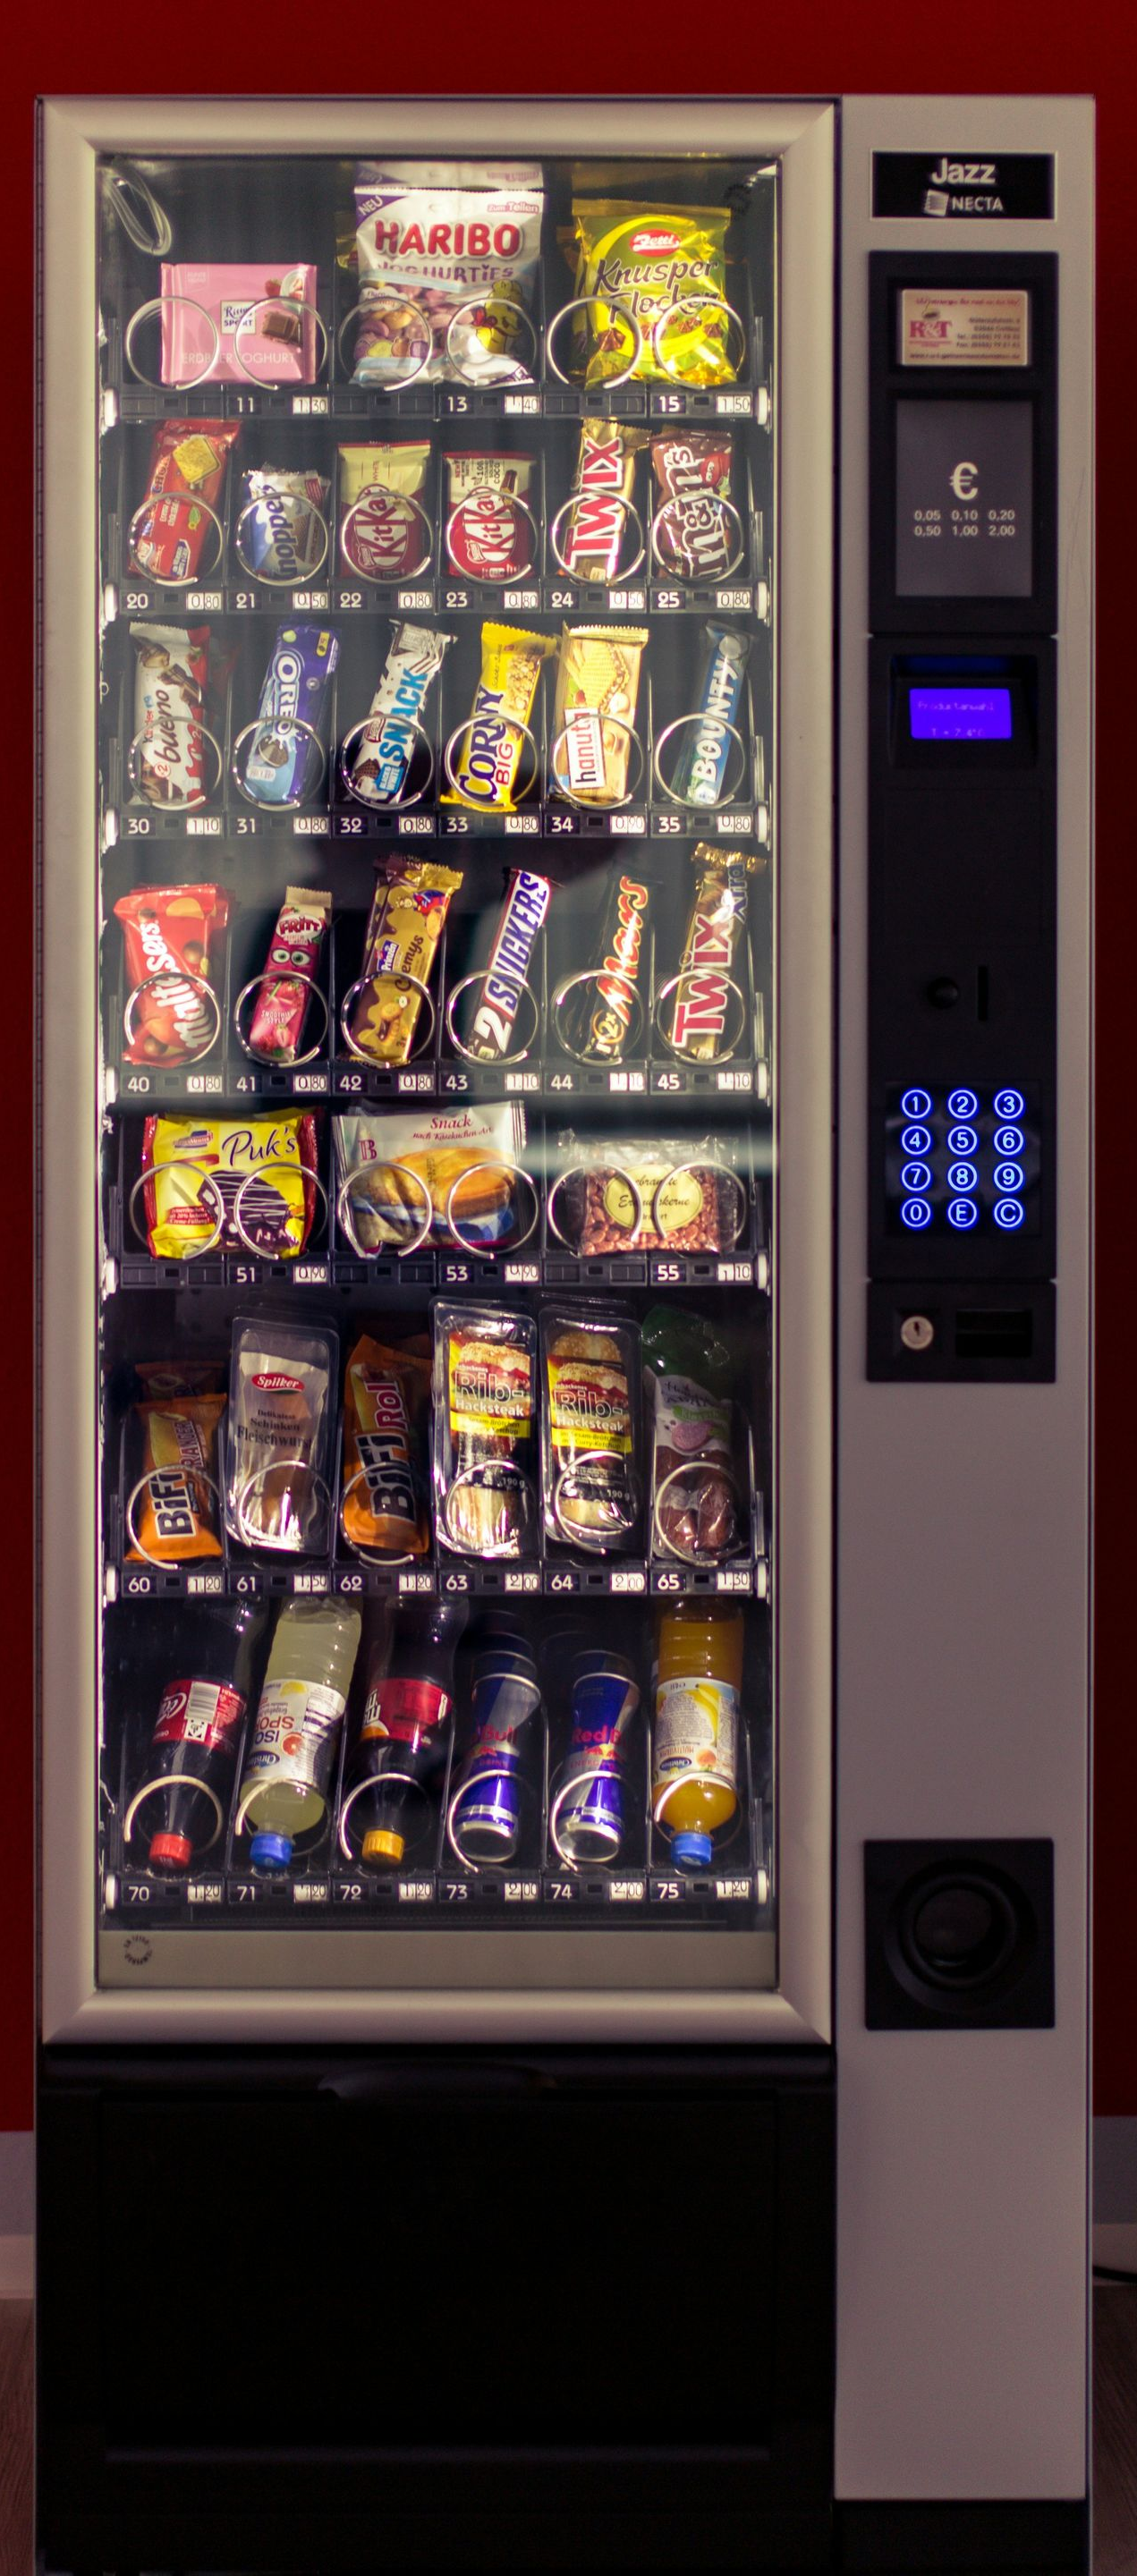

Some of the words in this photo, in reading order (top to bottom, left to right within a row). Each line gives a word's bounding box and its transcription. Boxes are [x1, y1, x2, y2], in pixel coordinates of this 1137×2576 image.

[931, 157, 997, 185] Jazz
[359, 194, 384, 216] NEU
[952, 196, 1005, 212] NECTA
[374, 219, 522, 257] HARIBO
[592, 258, 718, 295] Knusper
[236, 396, 254, 413] 11
[447, 396, 467, 412] 13
[659, 395, 680, 412] 15
[950, 462, 978, 500] €
[564, 436, 624, 571] TWIX
[127, 593, 148, 608] 20
[236, 593, 255, 608] 21
[340, 592, 361, 607] 22
[446, 592, 468, 607] 23
[551, 592, 573, 607] 24
[658, 592, 680, 607] 25
[275, 654, 301, 735] OREO
[379, 668, 428, 762] SNACK
[692, 658, 739, 783] BOUNTY
[154, 690, 181, 763] bueno
[459, 684, 505, 801] CORNY
[496, 743, 513, 785] BIG
[128, 818, 149, 834] 30
[237, 818, 256, 834] 31
[340, 818, 361, 833] 32
[446, 817, 468, 832] 33
[551, 817, 573, 832] 34
[658, 817, 680, 832] 35
[488, 872, 547, 1010] SNICKERS
[597, 876, 648, 1025] Mars
[673, 914, 732, 1046] TWIX
[128, 1077, 149, 1092] 40
[236, 1076, 256, 1091] 41
[340, 1074, 361, 1091] 42
[446, 1074, 467, 1090] 43
[551, 1074, 573, 1090] 44
[658, 1074, 679, 1090] 45
[912, 1096, 919, 1112] 1
[957, 1096, 969, 1113] 2
[1003, 1096, 1015, 1113] 3
[430, 1114, 471, 1130] Snack
[222, 1128, 297, 1166] Puk's
[909, 1131, 921, 1148] 4
[956, 1131, 969, 1148] 5
[1002, 1131, 1015, 1149] 6
[911, 1168, 921, 1185] 7
[956, 1168, 969, 1185] 8
[1002, 1168, 1015, 1185] 9
[910, 1204, 922, 1221] 0
[955, 1204, 967, 1221] E
[1000, 1204, 1016, 1222] C
[237, 1267, 256, 1282] 51
[446, 1267, 468, 1281] 53
[658, 1266, 679, 1280] 55
[455, 1399, 524, 1417] Hacksteak
[554, 1390, 624, 1420] Rib-
[250, 1418, 301, 1431] Schinken
[556, 1415, 624, 1433] Hacksteak
[128, 1577, 150, 1592] 60
[237, 1576, 257, 1592] 61
[340, 1576, 362, 1591] 62
[446, 1576, 468, 1591] 63
[551, 1575, 573, 1590] 64
[658, 1574, 680, 1590] 65
[573, 1724, 607, 1743] Red
[128, 1886, 149, 1902] 70
[237, 1885, 256, 1901] 71
[340, 1885, 361, 1900] 72
[446, 1885, 468, 1900] 73
[551, 1884, 573, 1900] 74
[658, 1883, 679, 1898] 75
